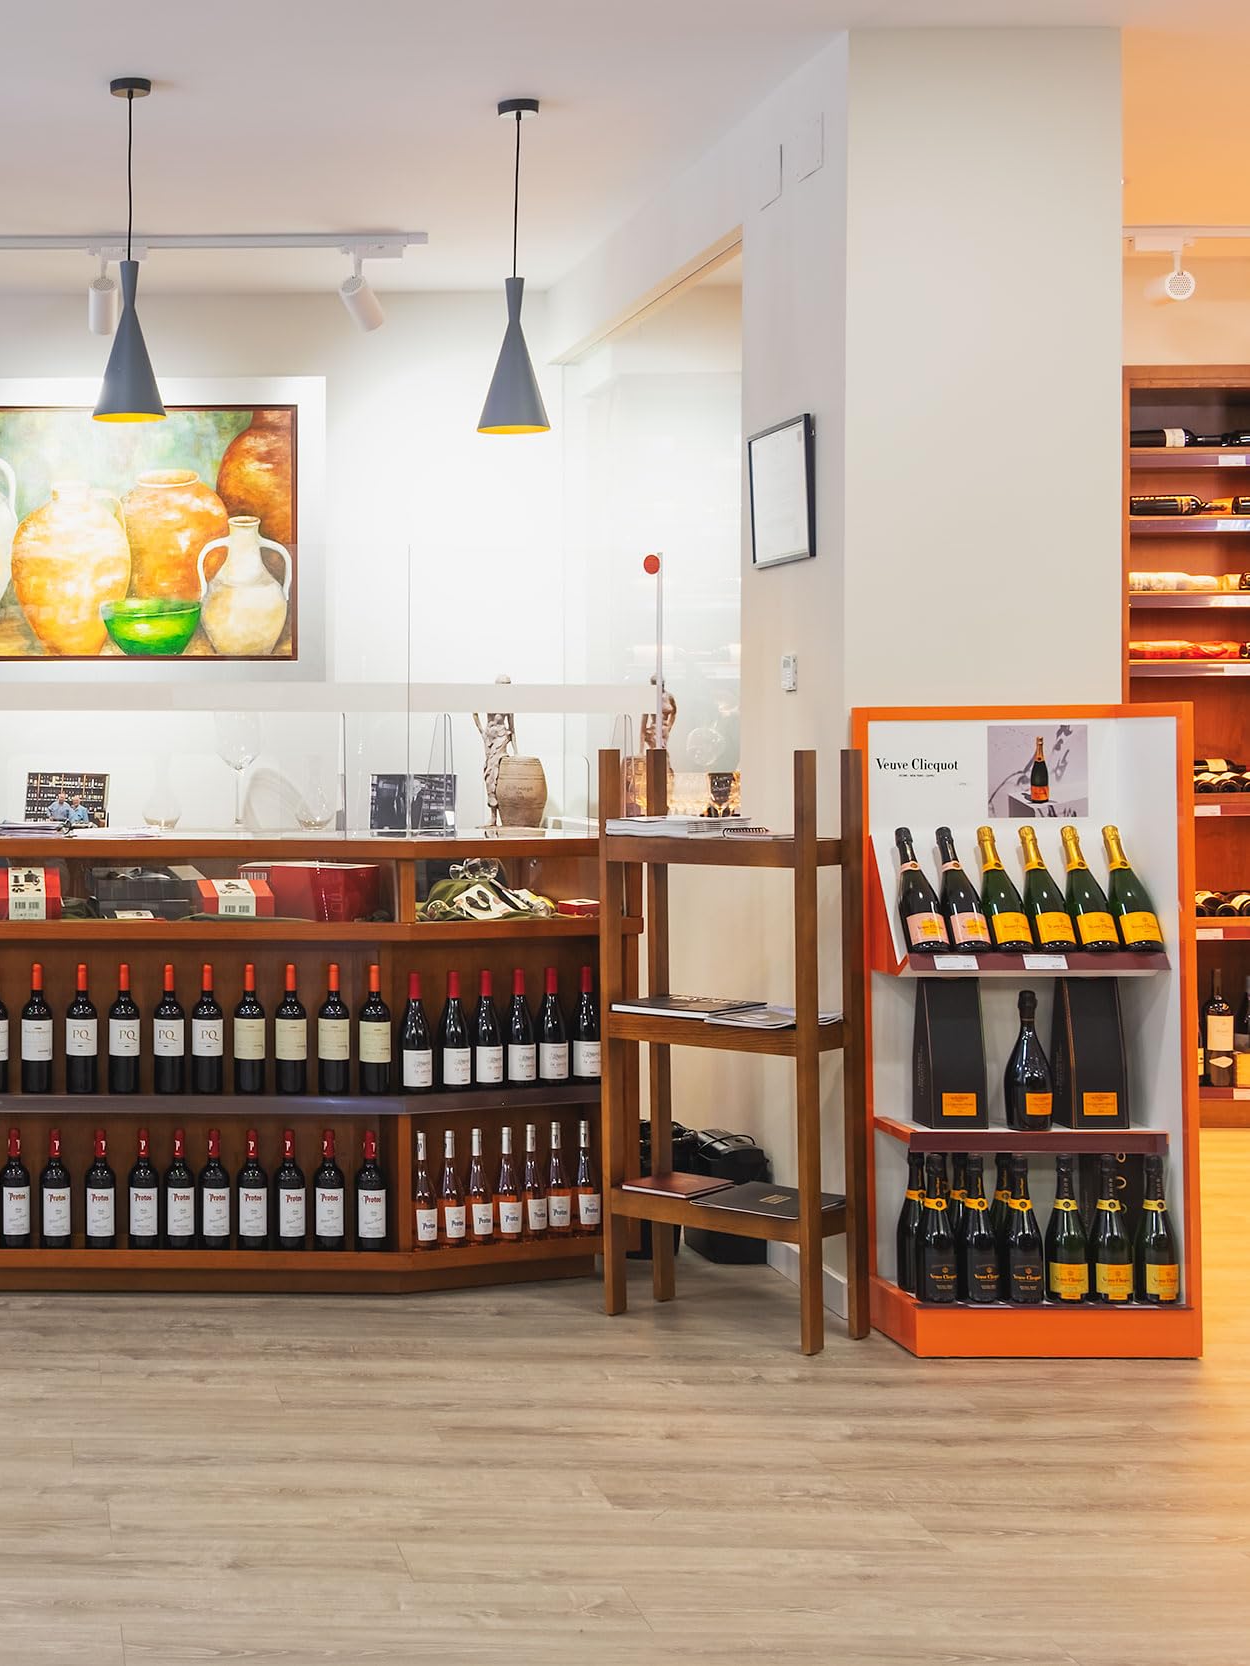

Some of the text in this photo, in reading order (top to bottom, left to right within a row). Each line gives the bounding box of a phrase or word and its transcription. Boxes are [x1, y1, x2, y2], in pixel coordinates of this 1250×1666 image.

[876, 757, 959, 773] Veuve Clicquot
[72, 1029, 92, 1041] PQ
[119, 1029, 138, 1042] PQ
[158, 1029, 178, 1042] PQ
[201, 1029, 220, 1042] PQ
[8, 1191, 26, 1202] Protos
[49, 1193, 67, 1203] Protos
[91, 1192, 109, 1203] Protos
[134, 1192, 152, 1203] Protos
[173, 1192, 191, 1203] Protos
[208, 1193, 226, 1203] Protos
[244, 1192, 262, 1202] Protos
[285, 1193, 302, 1203] Protos
[320, 1192, 339, 1203] Protos
[363, 1194, 382, 1205] Protos
